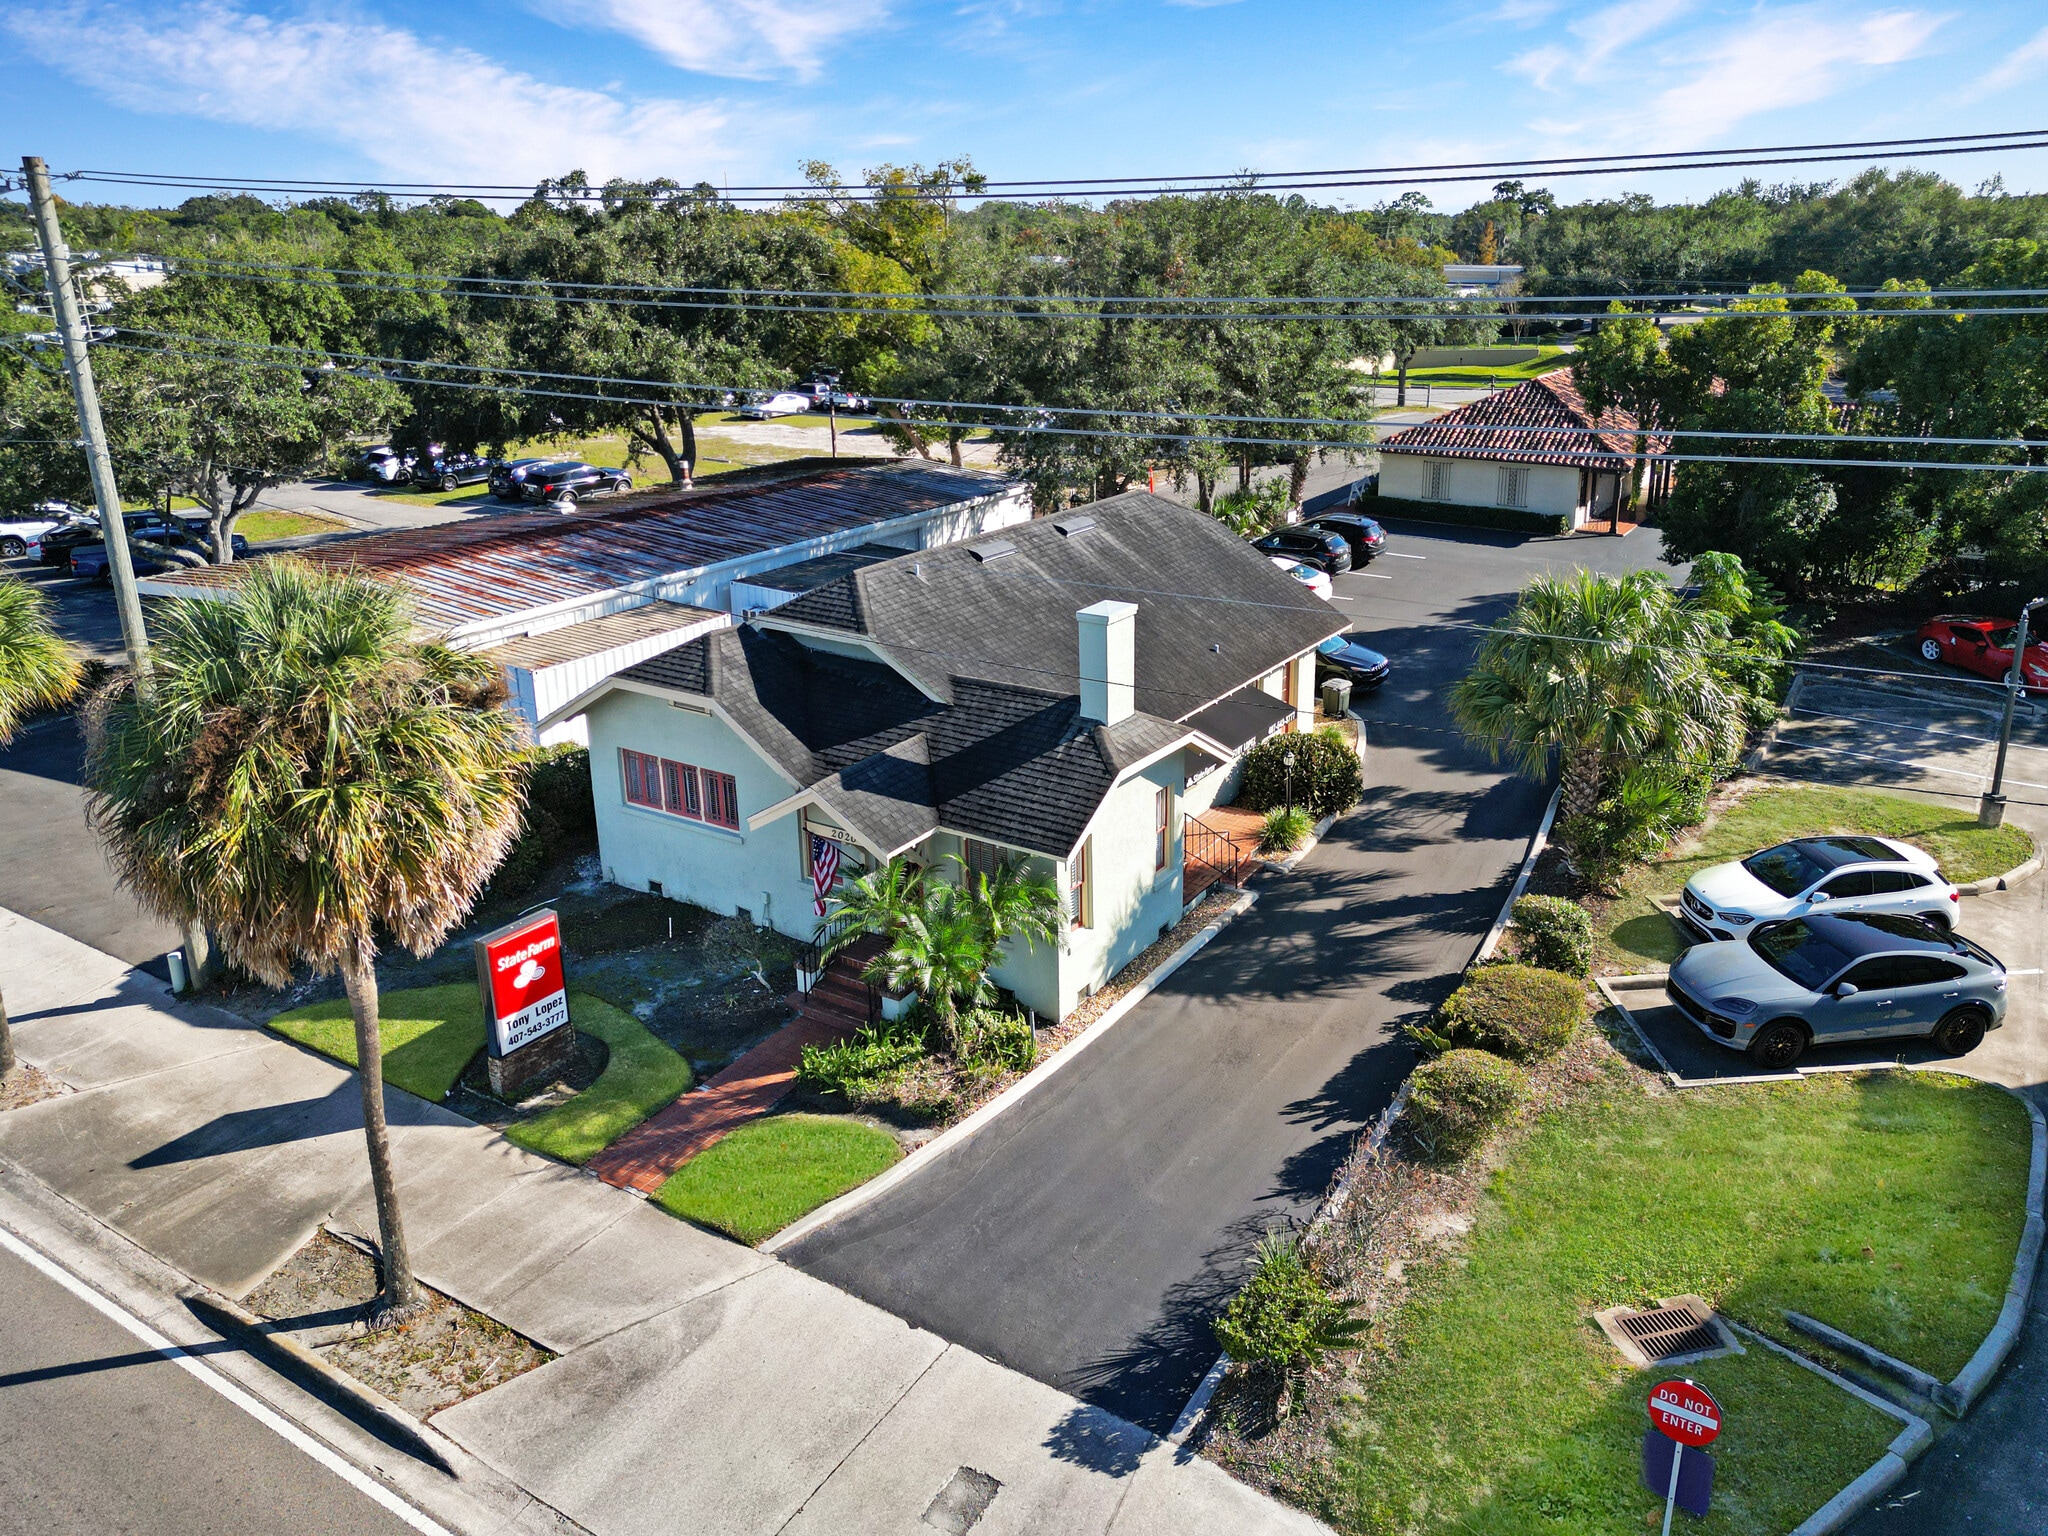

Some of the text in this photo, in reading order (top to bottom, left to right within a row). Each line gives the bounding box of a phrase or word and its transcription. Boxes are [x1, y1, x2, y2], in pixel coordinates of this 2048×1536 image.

[506, 996, 564, 1032] Tony Lopez
[508, 1010, 564, 1046] 407-543-3777
[1659, 1388, 1712, 1417] DO NOT
[1662, 1412, 1703, 1437] ENTER
